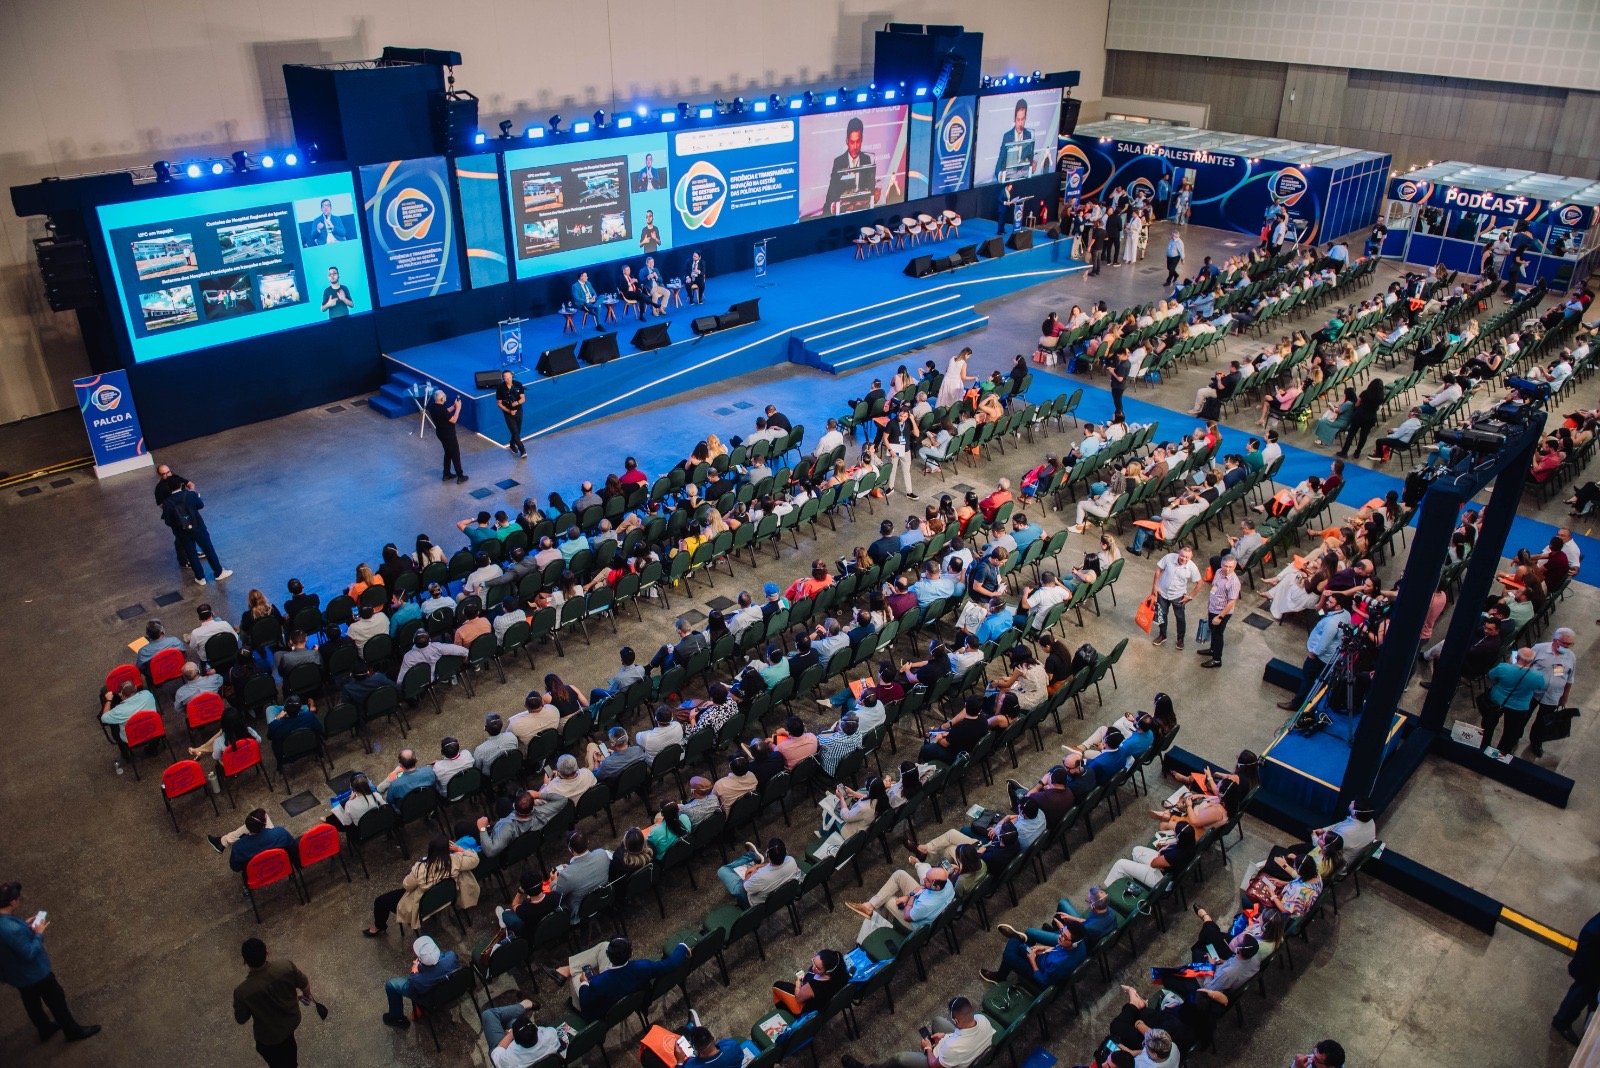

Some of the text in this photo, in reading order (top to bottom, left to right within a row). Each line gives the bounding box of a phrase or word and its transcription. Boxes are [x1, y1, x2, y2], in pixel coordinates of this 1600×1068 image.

[1117, 142, 1236, 167] SALA DE PALESTRANTES
[730, 174, 755, 183] EFICIÊNCIA
[730, 180, 753, 190] INOVAÇÃO
[740, 186, 762, 195] POLÍTICAS
[1444, 189, 1529, 215] PODCAST
[93, 412, 132, 428] PALCO A
